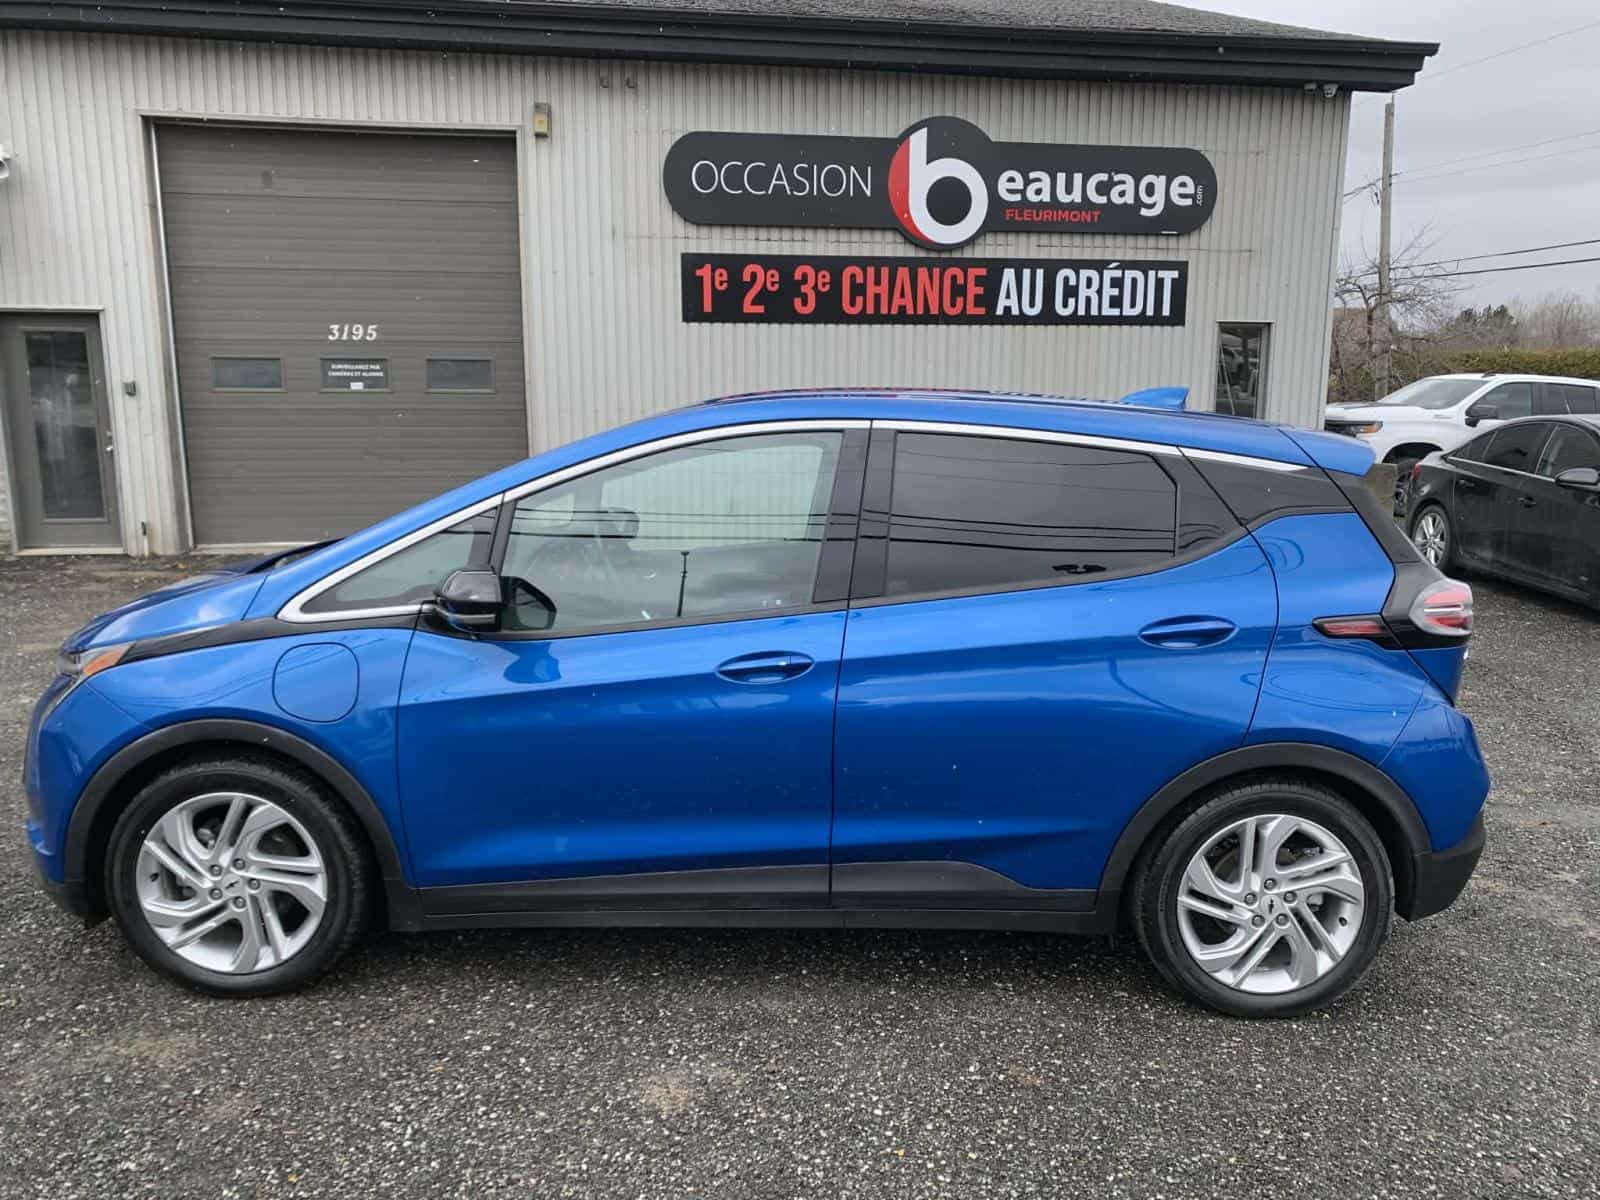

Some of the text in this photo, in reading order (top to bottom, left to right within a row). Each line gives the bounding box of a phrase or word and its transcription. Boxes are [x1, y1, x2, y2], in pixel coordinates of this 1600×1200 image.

[691, 160, 872, 198] OCCASION
[1005, 208, 1100, 223] FLEURIMONT
[695, 262, 1179, 317] 1e 2e 3e CHANCE AU CRÉDIT
[328, 323, 378, 342] 3195
